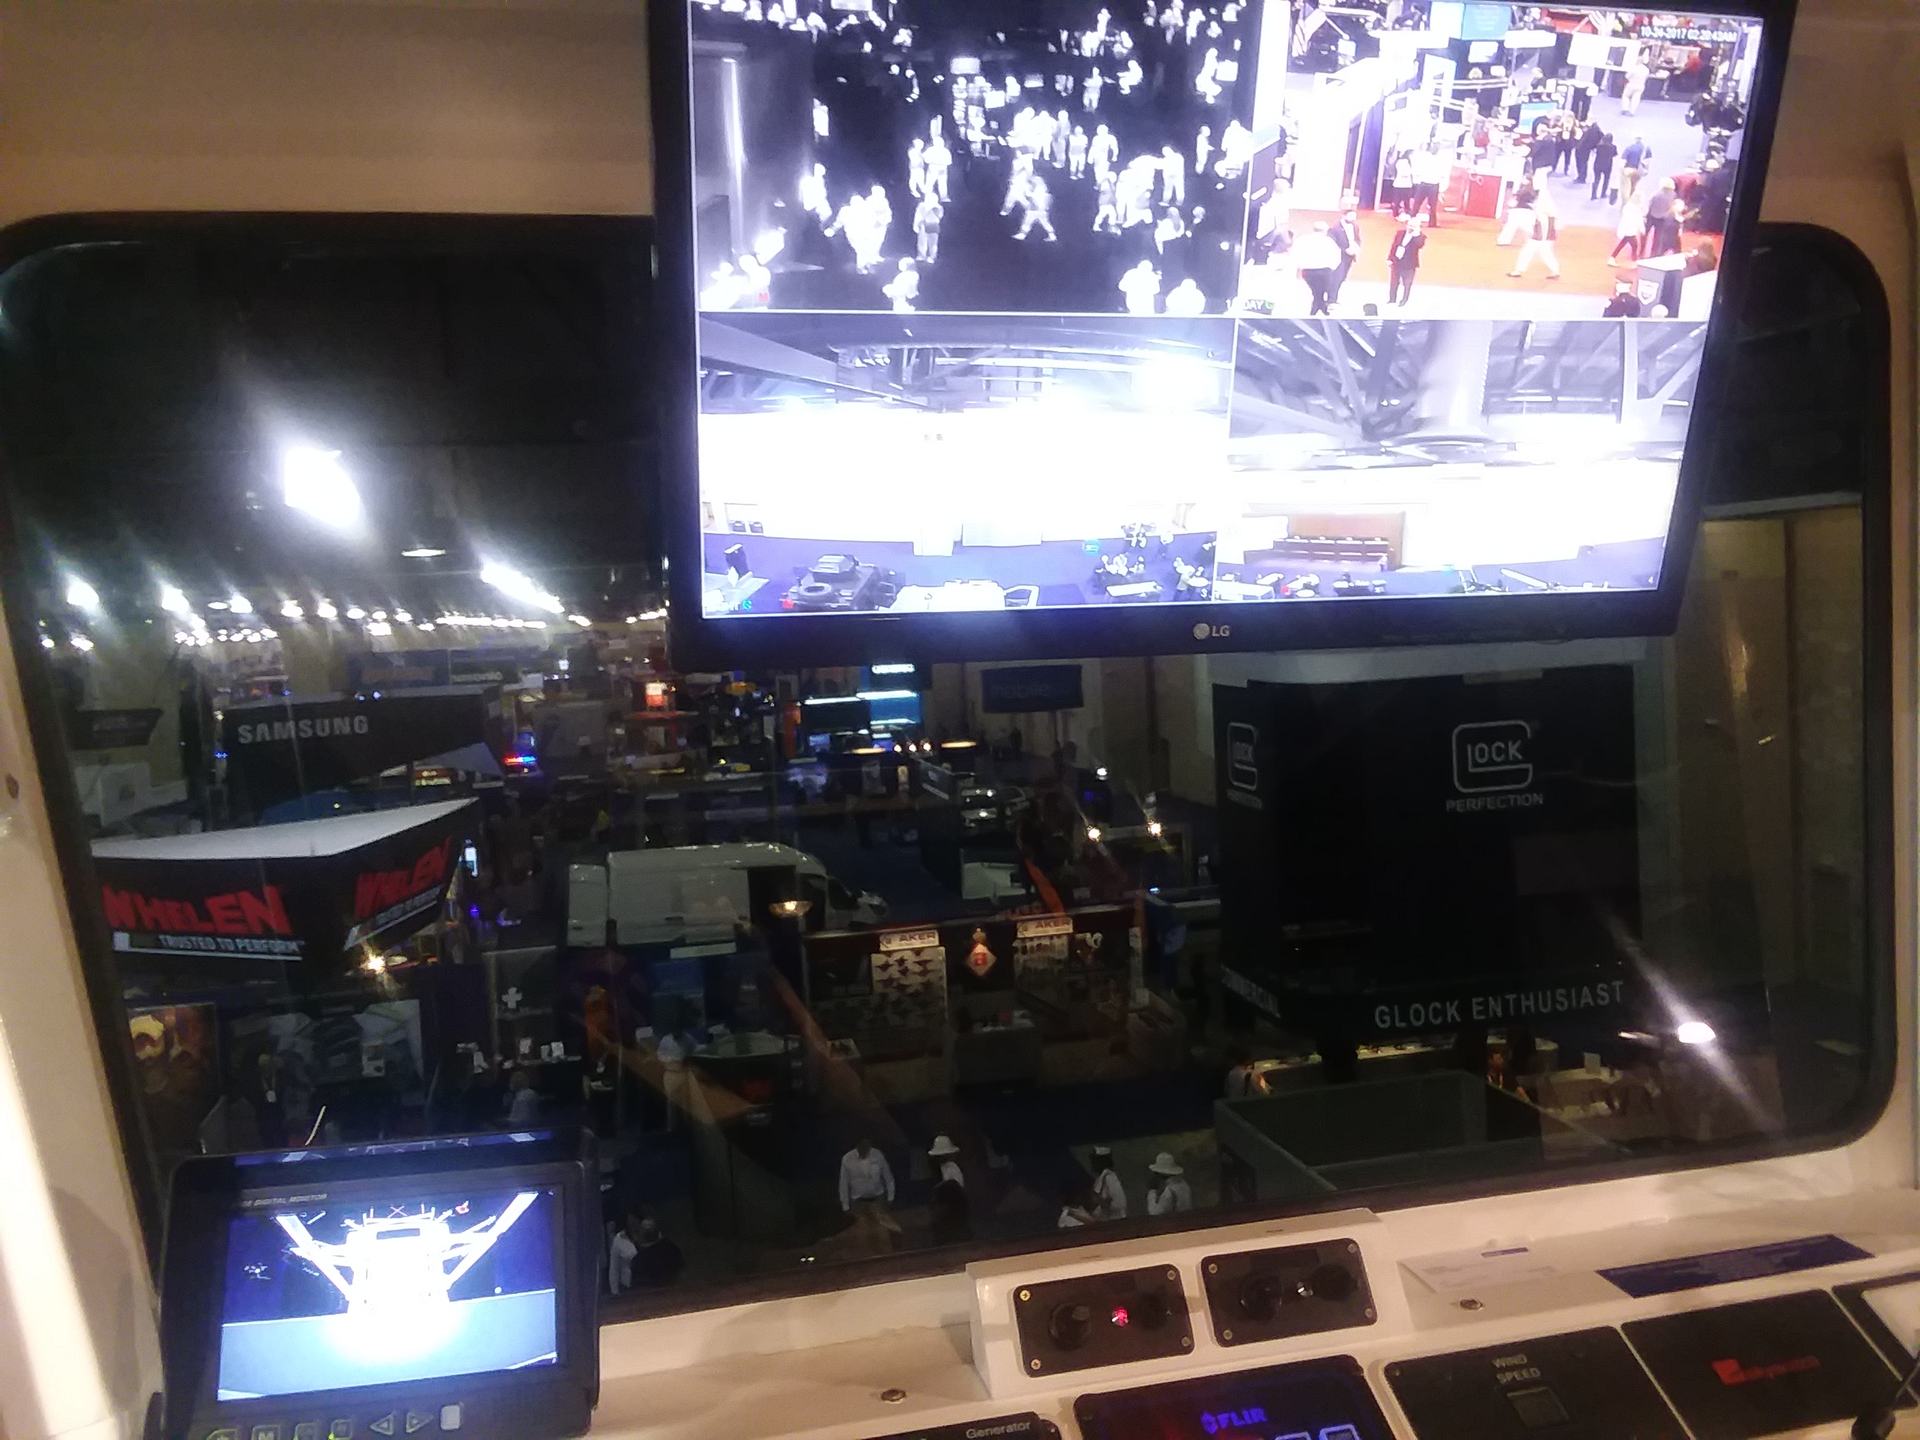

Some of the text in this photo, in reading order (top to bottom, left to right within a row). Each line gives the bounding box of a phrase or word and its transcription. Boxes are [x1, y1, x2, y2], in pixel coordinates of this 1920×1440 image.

[1211, 624, 1231, 638] LG
[237, 714, 370, 745] SAMSUNG
[1445, 792, 1544, 812] PERFECTION
[101, 883, 293, 936] WHELEN
[899, 931, 936, 943] AKER
[1373, 979, 1625, 1029] GLOCK ENTHUSIAST
[1491, 1353, 1528, 1369] WIND
[1496, 1367, 1542, 1385] SPEED
[1216, 1407, 1268, 1428] FLIR
[965, 1421, 1031, 1439] Generator
